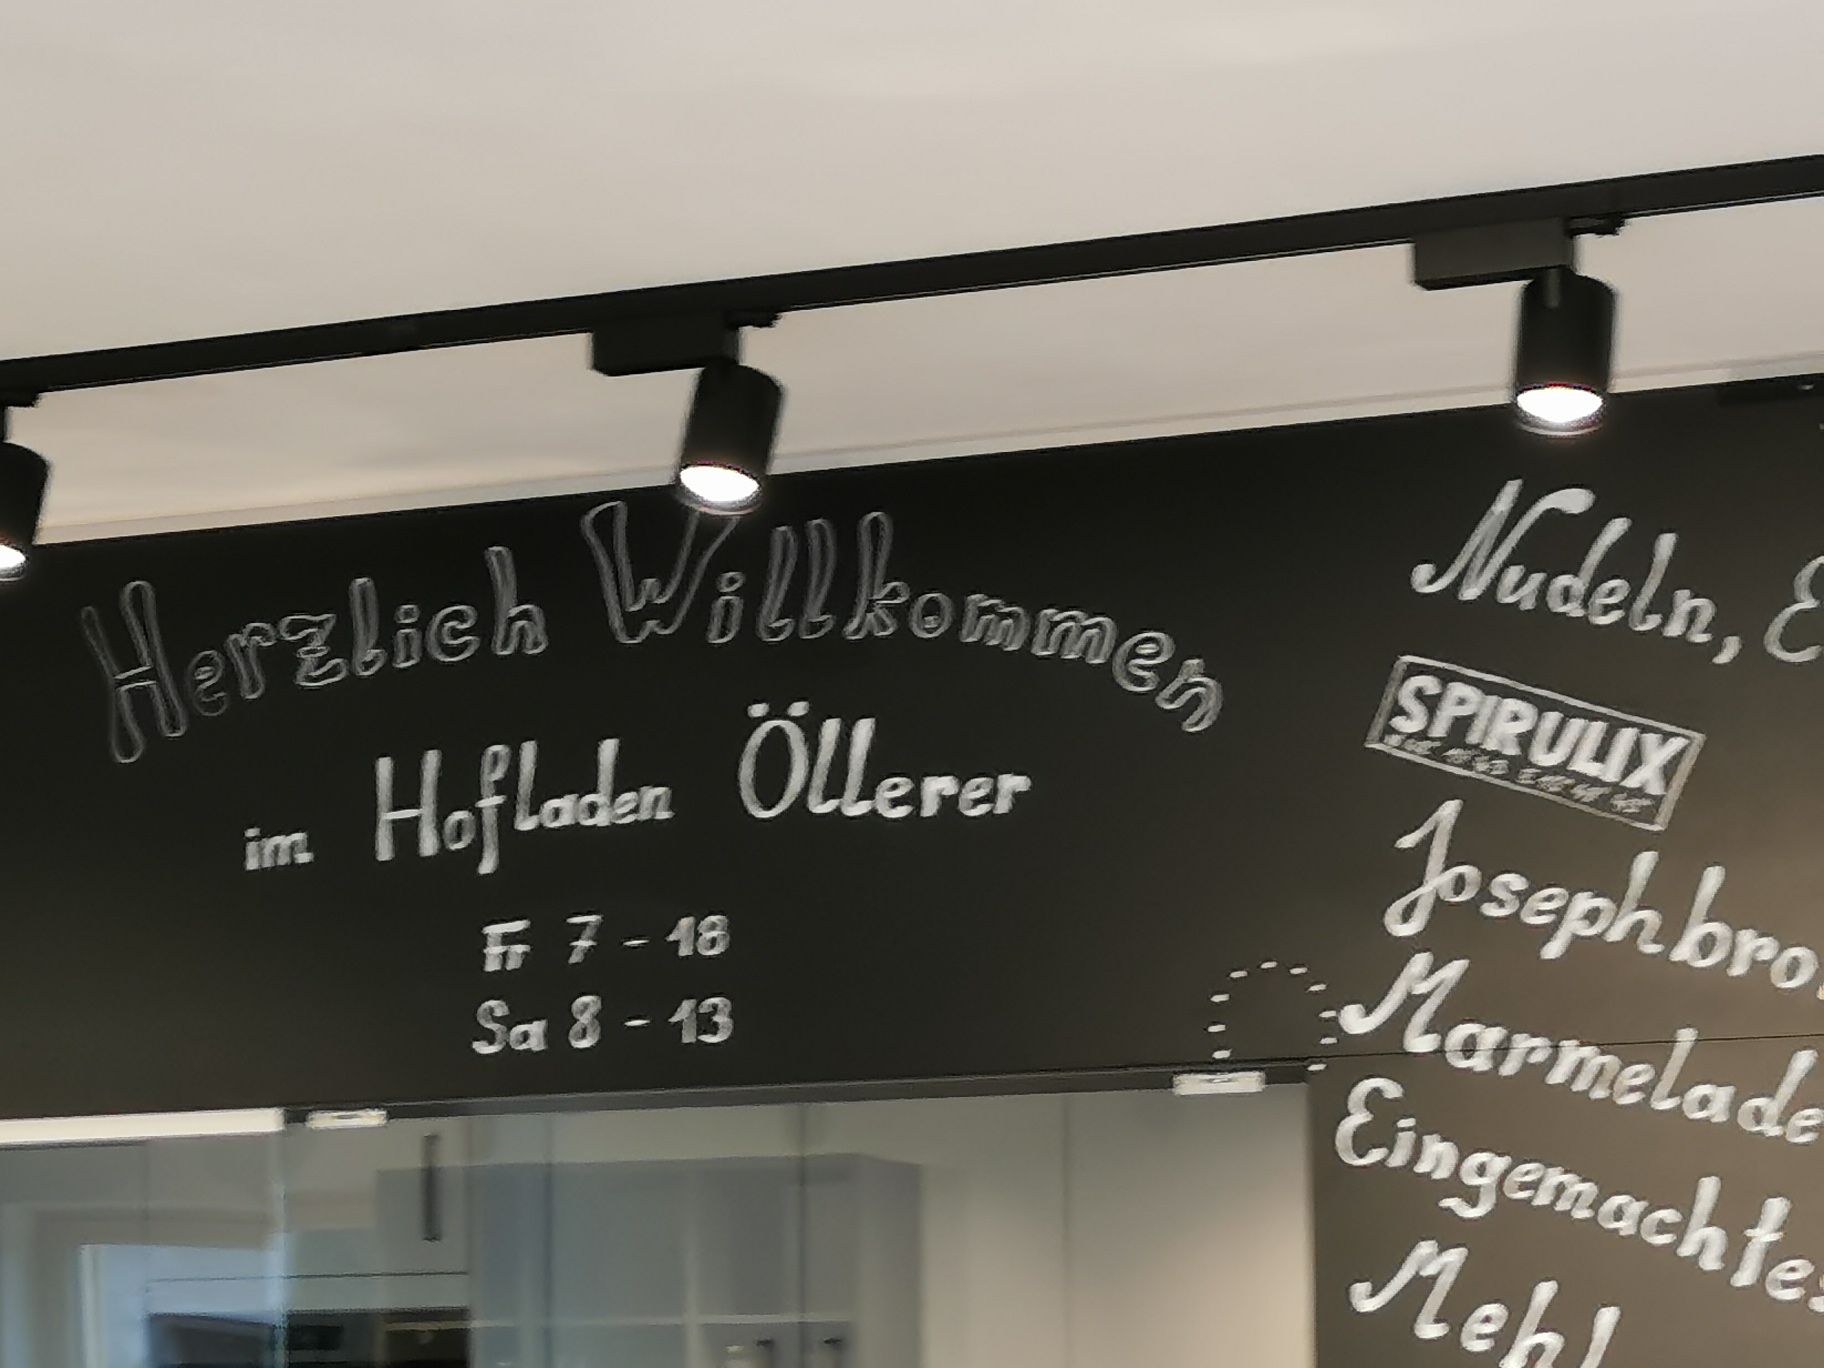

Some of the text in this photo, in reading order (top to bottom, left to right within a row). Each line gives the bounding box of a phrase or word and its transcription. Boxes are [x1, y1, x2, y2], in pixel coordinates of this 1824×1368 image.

[80, 500, 1224, 764] Herzlich Willkommen
[1410, 478, 1743, 664] Nudeln,
[244, 701, 1032, 874] im Hofladen Öllerer
[1388, 674, 1691, 796] SPIRULIX
[481, 918, 531, 972] Fr
[566, 914, 604, 965] 7
[664, 914, 730, 957] 18
[1383, 799, 1824, 1001] Josephbro
[471, 999, 549, 1054] Sa
[568, 995, 602, 1049] 8
[667, 996, 734, 1043] 13
[1338, 951, 1824, 1144] Marmelade
